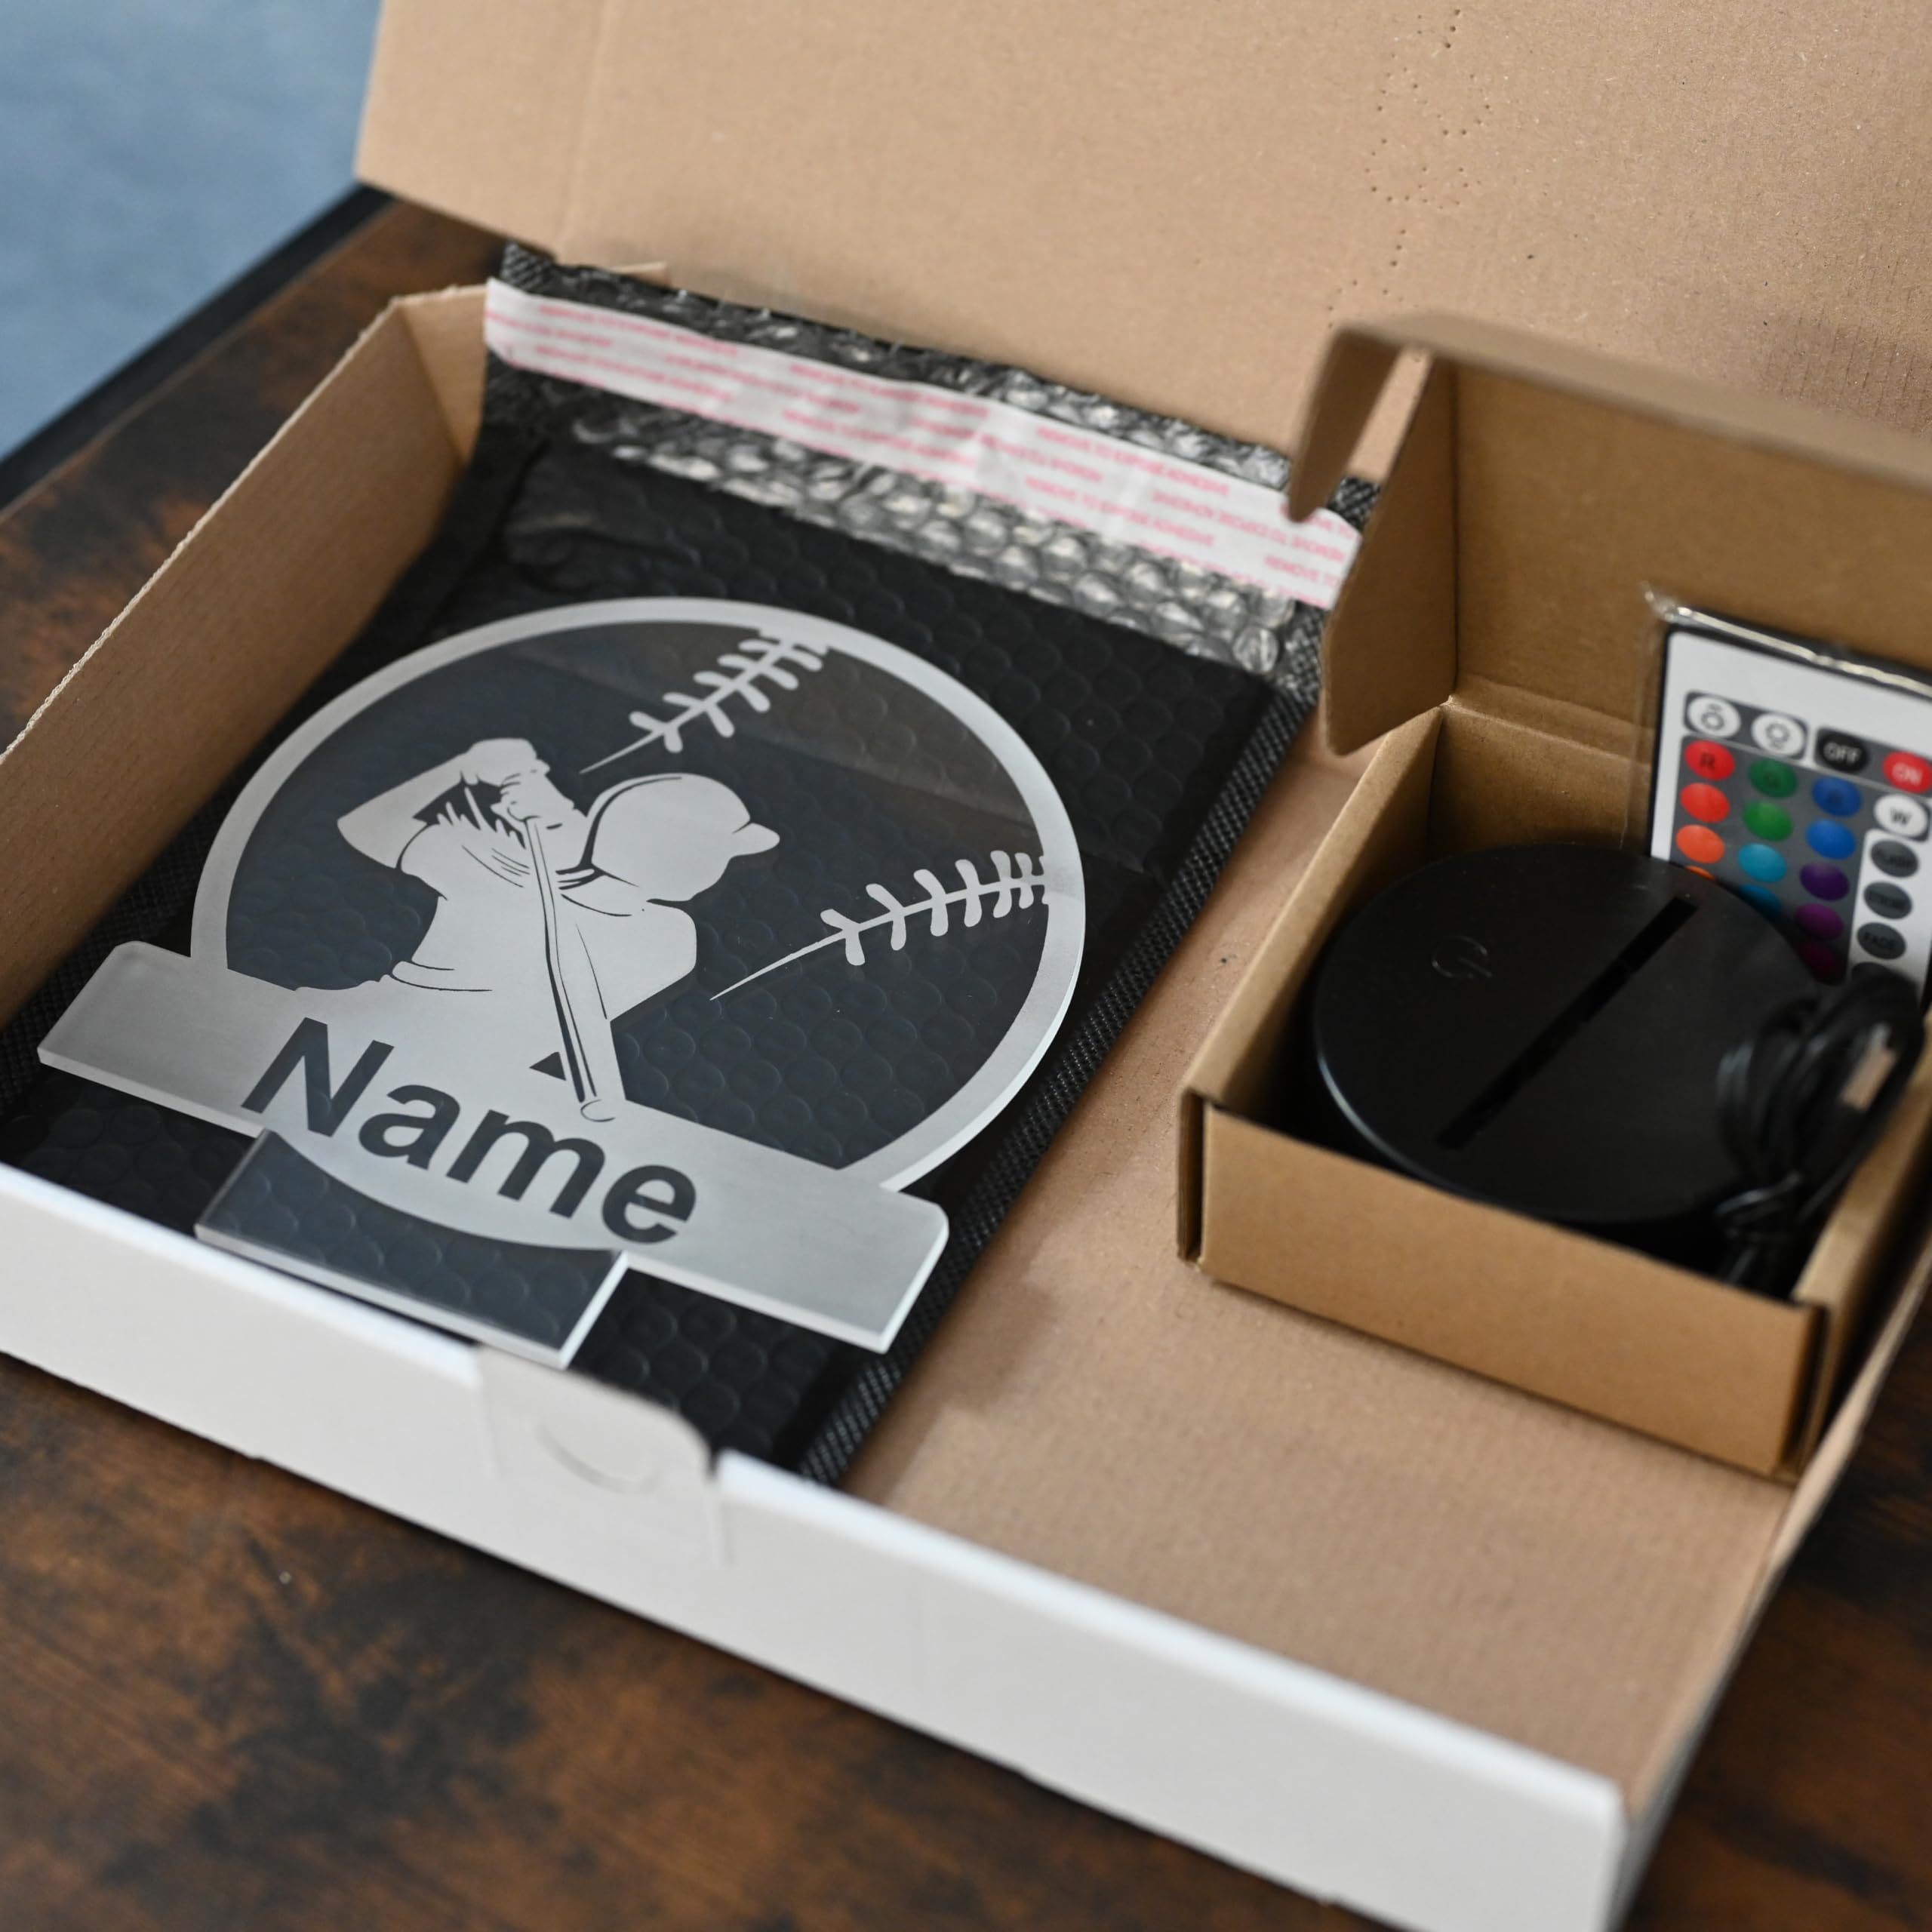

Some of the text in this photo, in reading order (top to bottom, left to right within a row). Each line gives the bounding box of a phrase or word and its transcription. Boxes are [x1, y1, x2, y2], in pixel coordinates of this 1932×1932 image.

[1700, 752, 1716, 771] R
[1823, 741, 1863, 765] OFF
[1891, 761, 1923, 788] ON
[1889, 806, 1913, 826] W
[241, 1017, 697, 1244] Name
